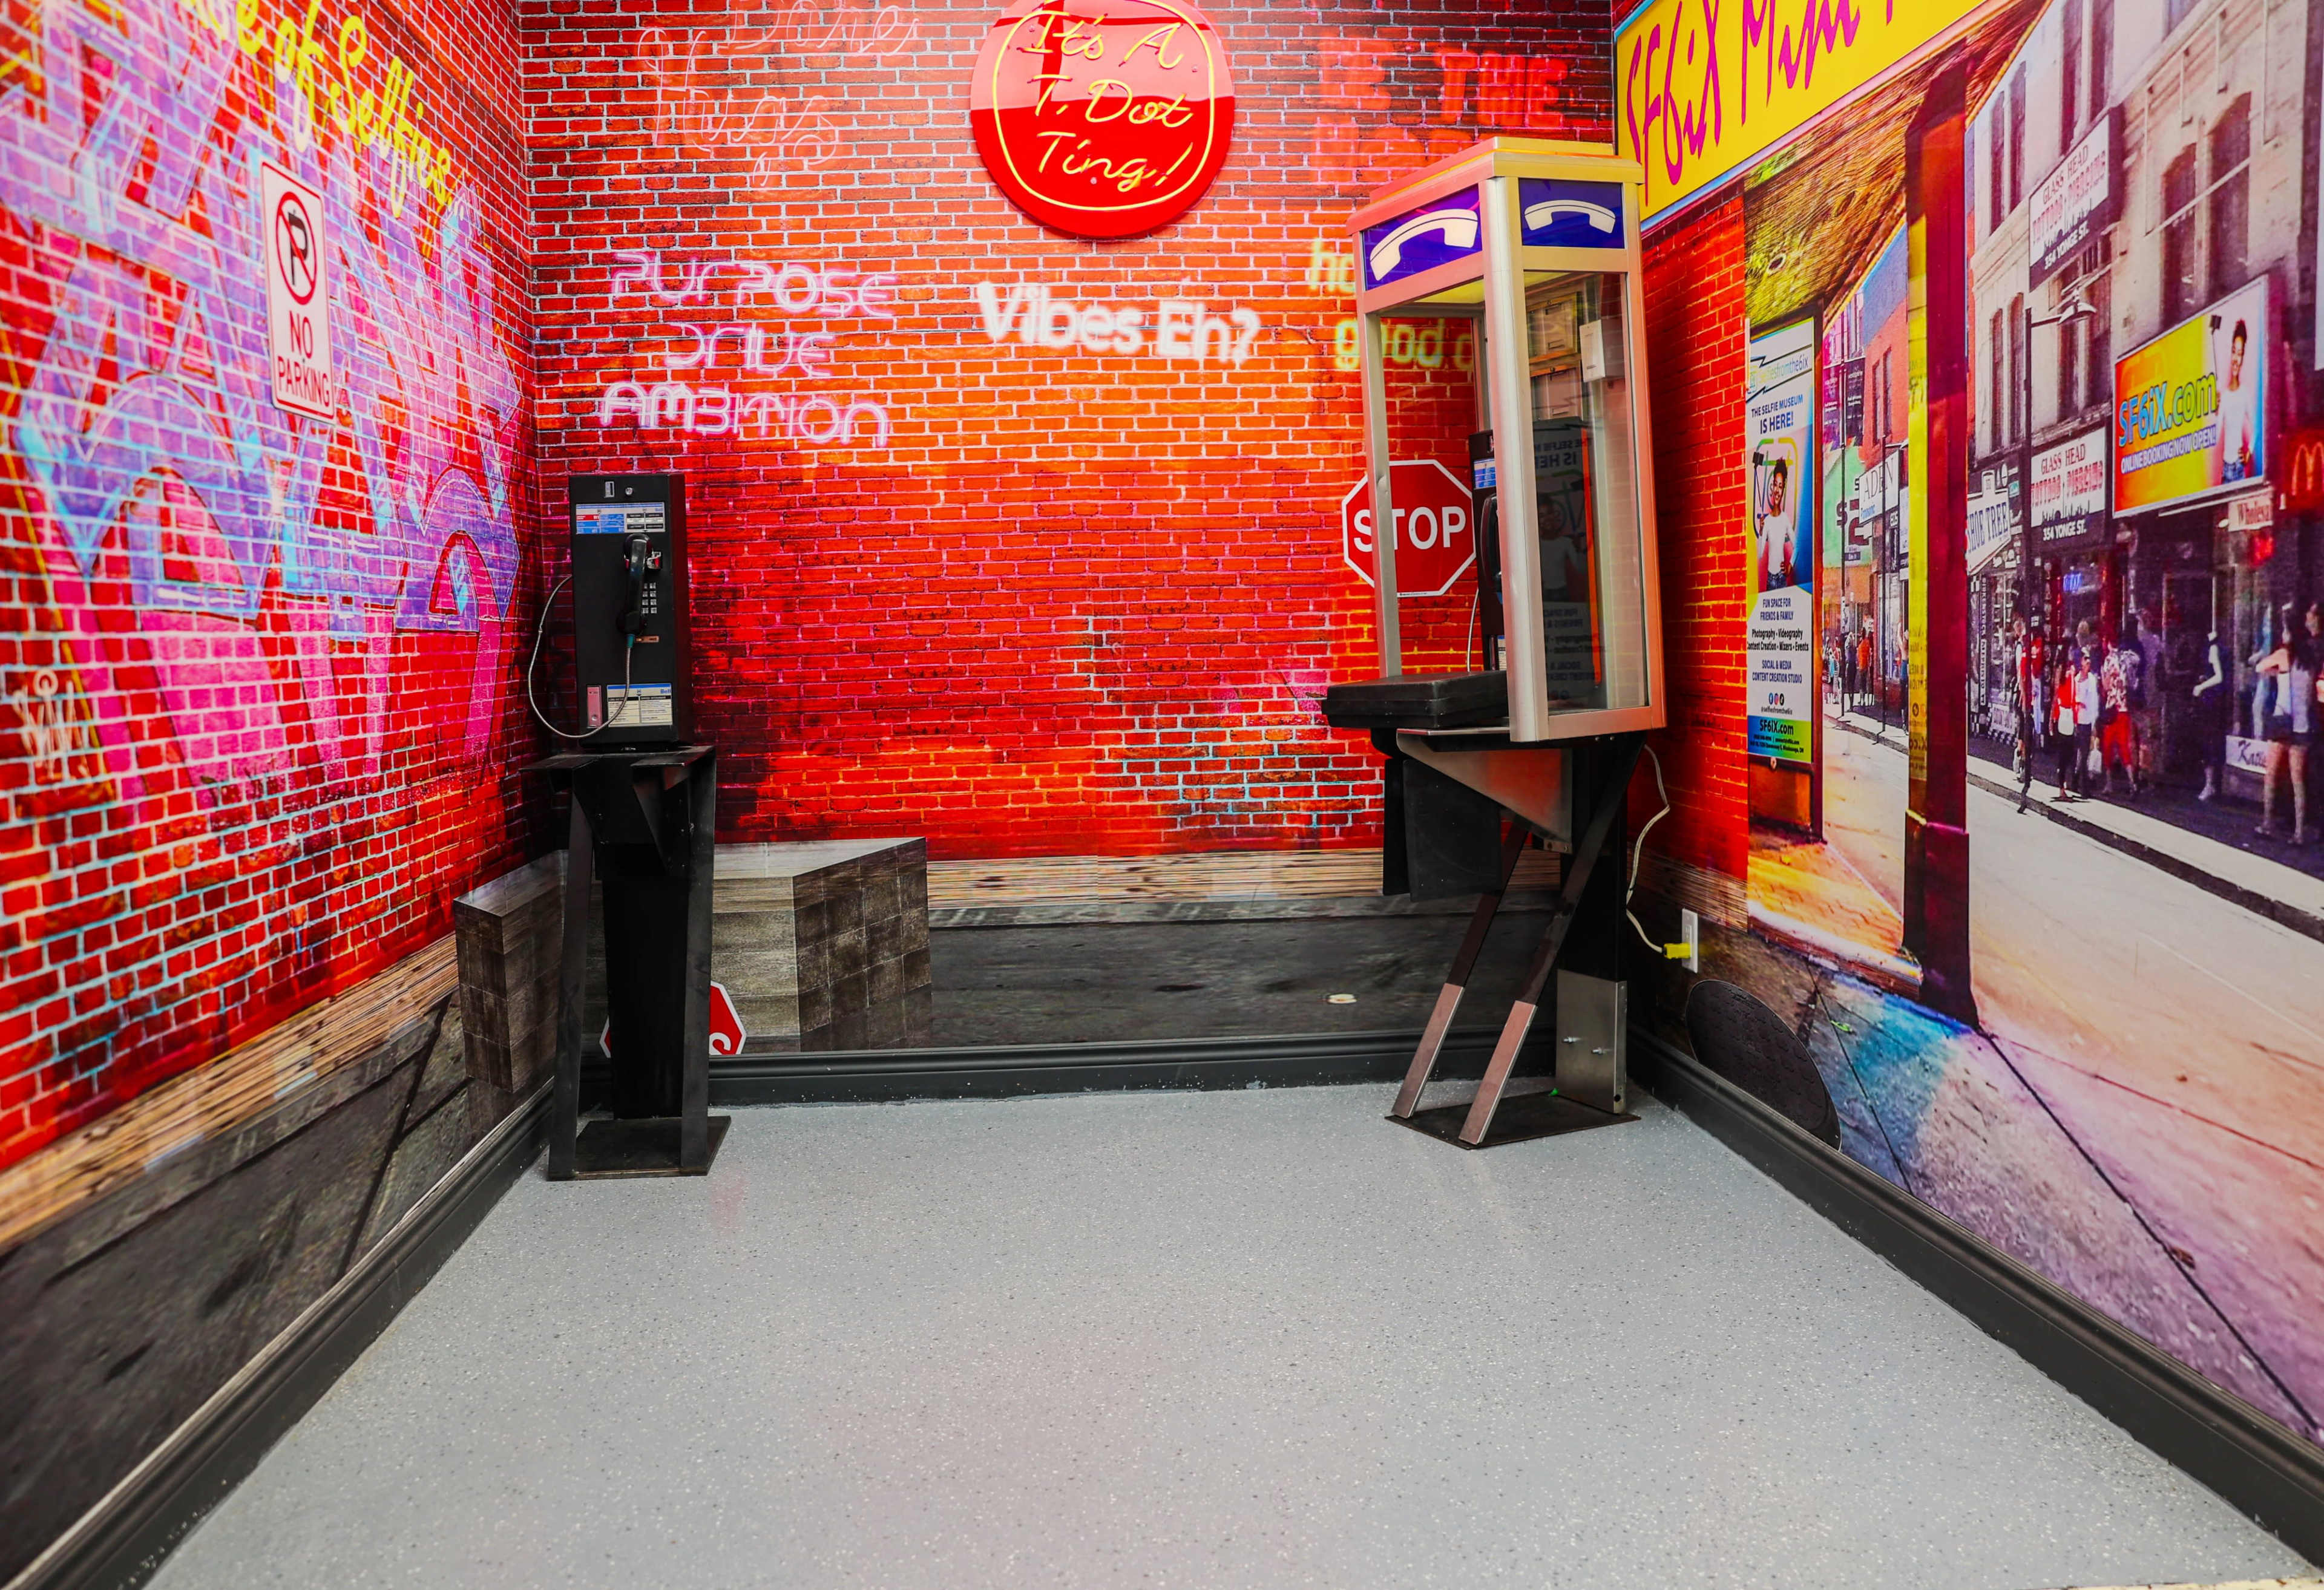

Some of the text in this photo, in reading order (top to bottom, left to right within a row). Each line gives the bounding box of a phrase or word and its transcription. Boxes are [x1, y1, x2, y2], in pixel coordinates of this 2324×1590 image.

[1123, 22, 1185, 69] A
[1085, 79, 1194, 128] Dot
[1434, 47, 1567, 128] THE
[1037, 131, 1193, 192] Ting!
[2043, 145, 2088, 204] GLASS HEAD
[2056, 228, 2079, 259] YONGE
[289, 310, 314, 360] NO
[976, 280, 1262, 365] Vibes Eh?
[1334, 317, 1446, 371] god
[277, 356, 330, 409] PARKING
[1751, 394, 1804, 418] THE SELFIE MUSEUM
[1760, 411, 1794, 434] IS HERE!
[2118, 371, 2218, 448] SF6iX.com
[2041, 443, 2086, 475] GLASS HEAD
[2121, 451, 2144, 474] ONLINE
[2143, 440, 2173, 466] BOOKING
[2173, 433, 2192, 458] NOW
[1353, 505, 1466, 553] STOP
[1986, 502, 2009, 541] TREE
[2043, 519, 2087, 541] 354 YONGE ST.
[1760, 611, 1776, 621] FRIENDS
[1780, 610, 1794, 620] FAMILY
[1771, 598, 1782, 607] SPACE
[1783, 597, 1791, 607] FOR
[1751, 628, 1804, 641] Photography Videography
[1761, 641, 1777, 650] Creation
[1779, 641, 1794, 651] Mixers
[1794, 641, 1809, 652] Events
[1752, 672, 1802, 684] CONTENT CREATION STUDIO
[1762, 660, 1775, 669] SOCIAL
[1779, 660, 1792, 670] MEDIA
